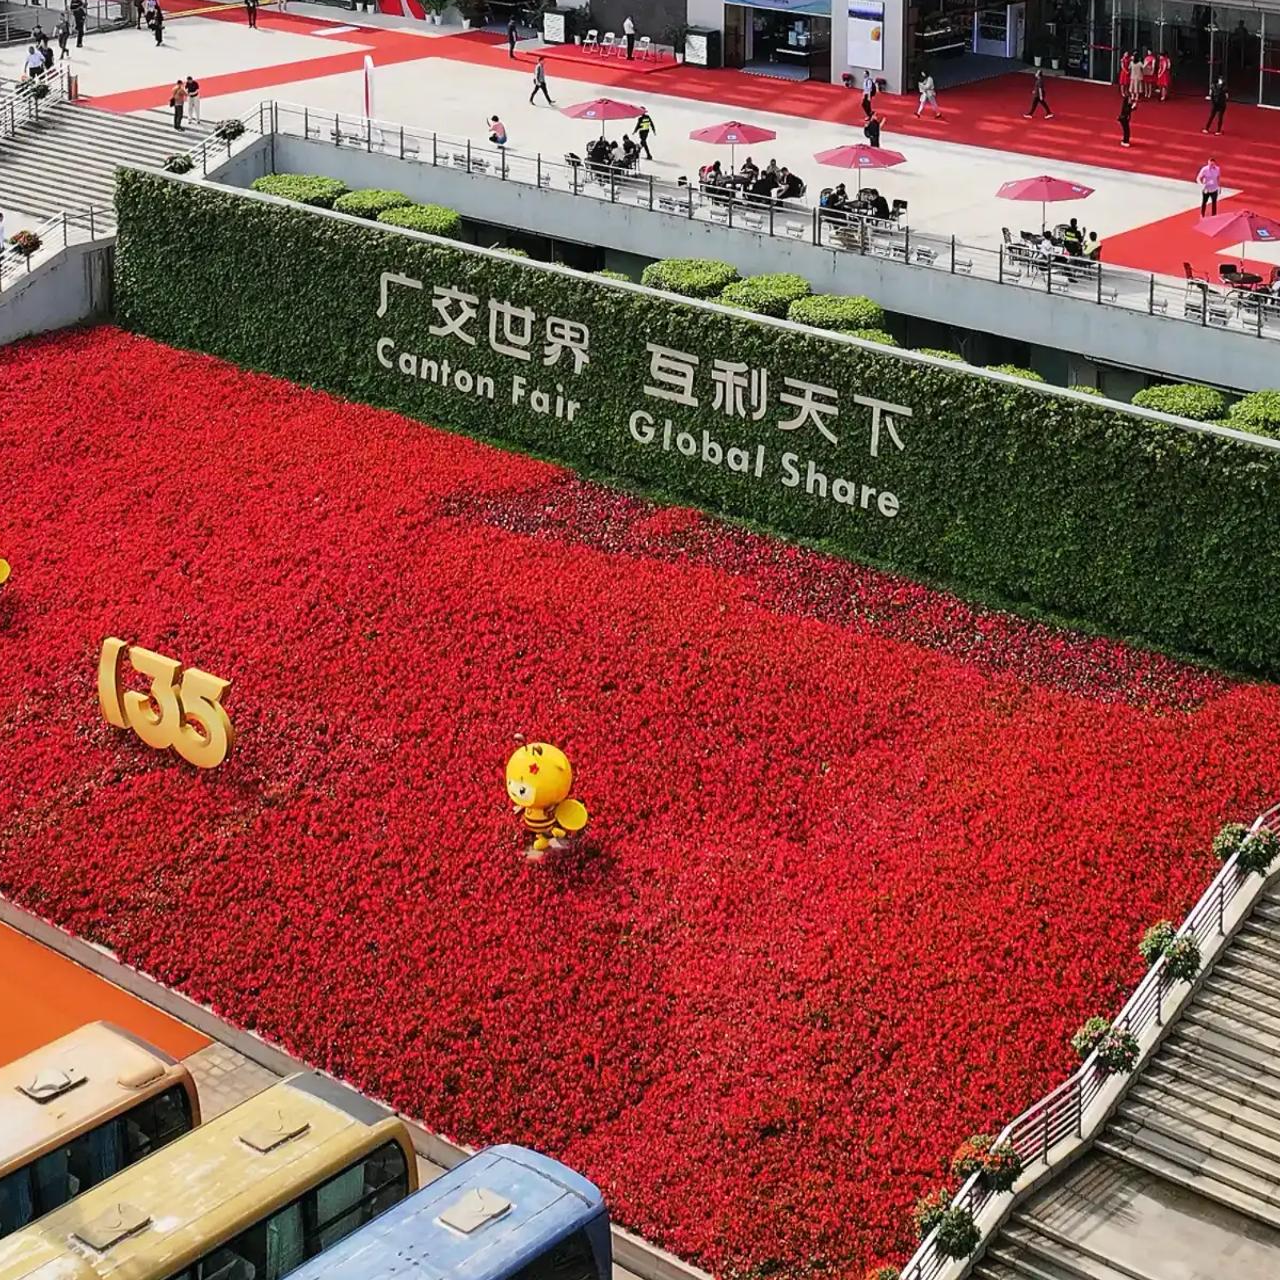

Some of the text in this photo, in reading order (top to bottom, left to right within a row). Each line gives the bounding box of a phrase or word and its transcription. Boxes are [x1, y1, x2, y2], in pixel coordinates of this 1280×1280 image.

[376, 271, 914, 458] 广交世界 互利天下
[376, 336, 901, 519] Canton Fair Global Share
[97, 635, 237, 769] 135
